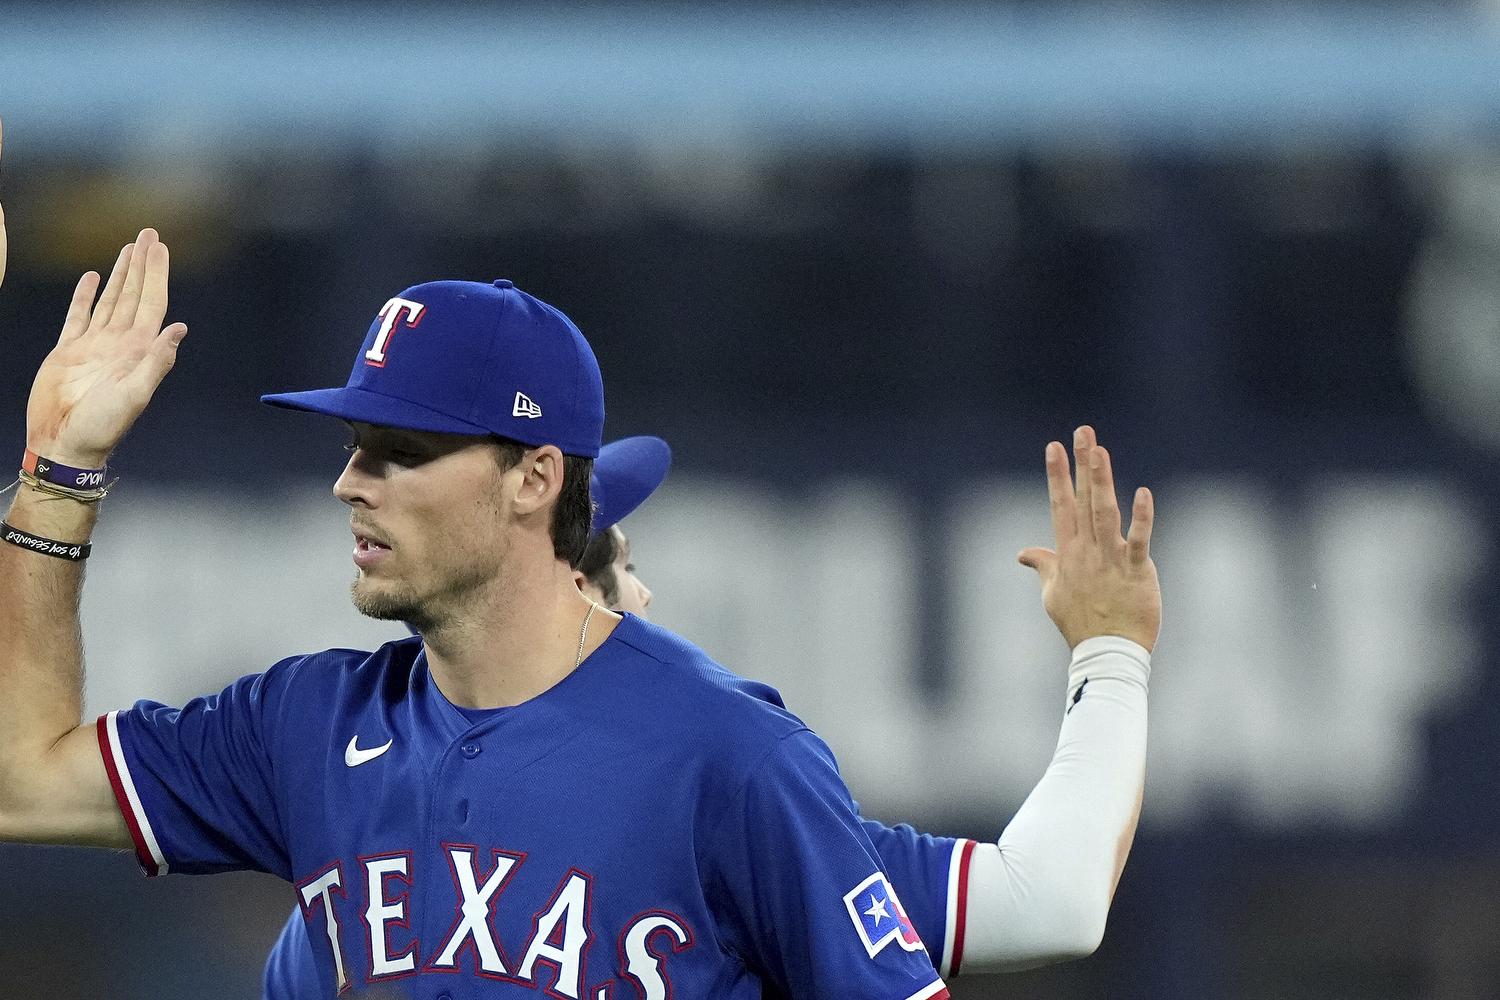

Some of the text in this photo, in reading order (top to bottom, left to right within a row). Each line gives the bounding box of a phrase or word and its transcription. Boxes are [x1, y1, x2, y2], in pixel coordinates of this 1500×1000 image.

[365, 297, 427, 368] T
[49, 543, 68, 556] SOY
[69, 545, 82, 559] YO
